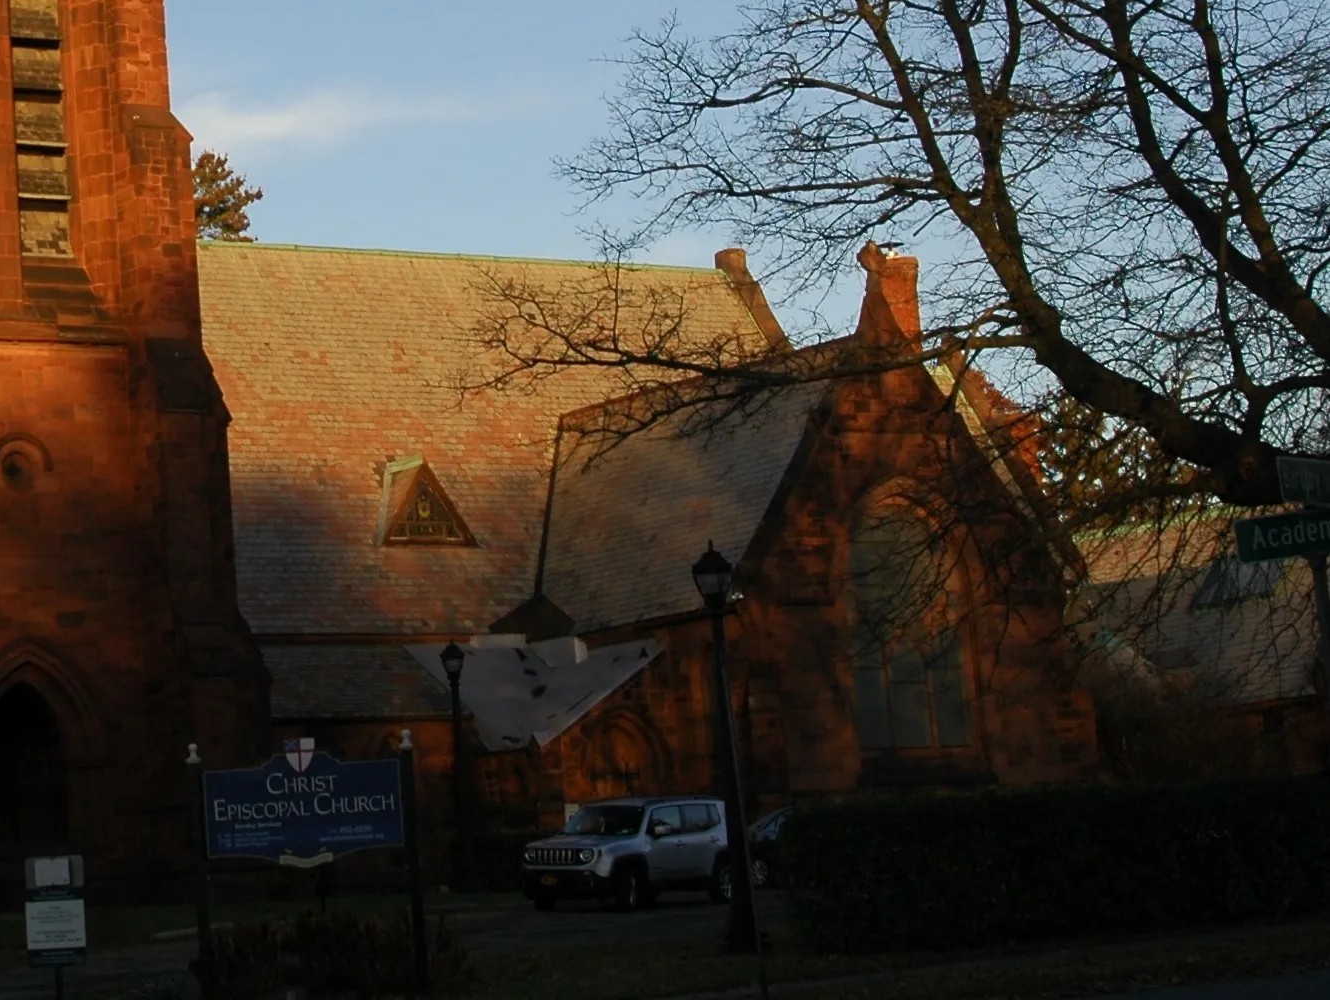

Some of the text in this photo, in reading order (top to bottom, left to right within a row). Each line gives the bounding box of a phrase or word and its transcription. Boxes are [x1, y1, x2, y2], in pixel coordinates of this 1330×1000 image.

[266, 772, 338, 795] CHRIST
[213, 792, 396, 822] EPISCOPAL CHURCH
